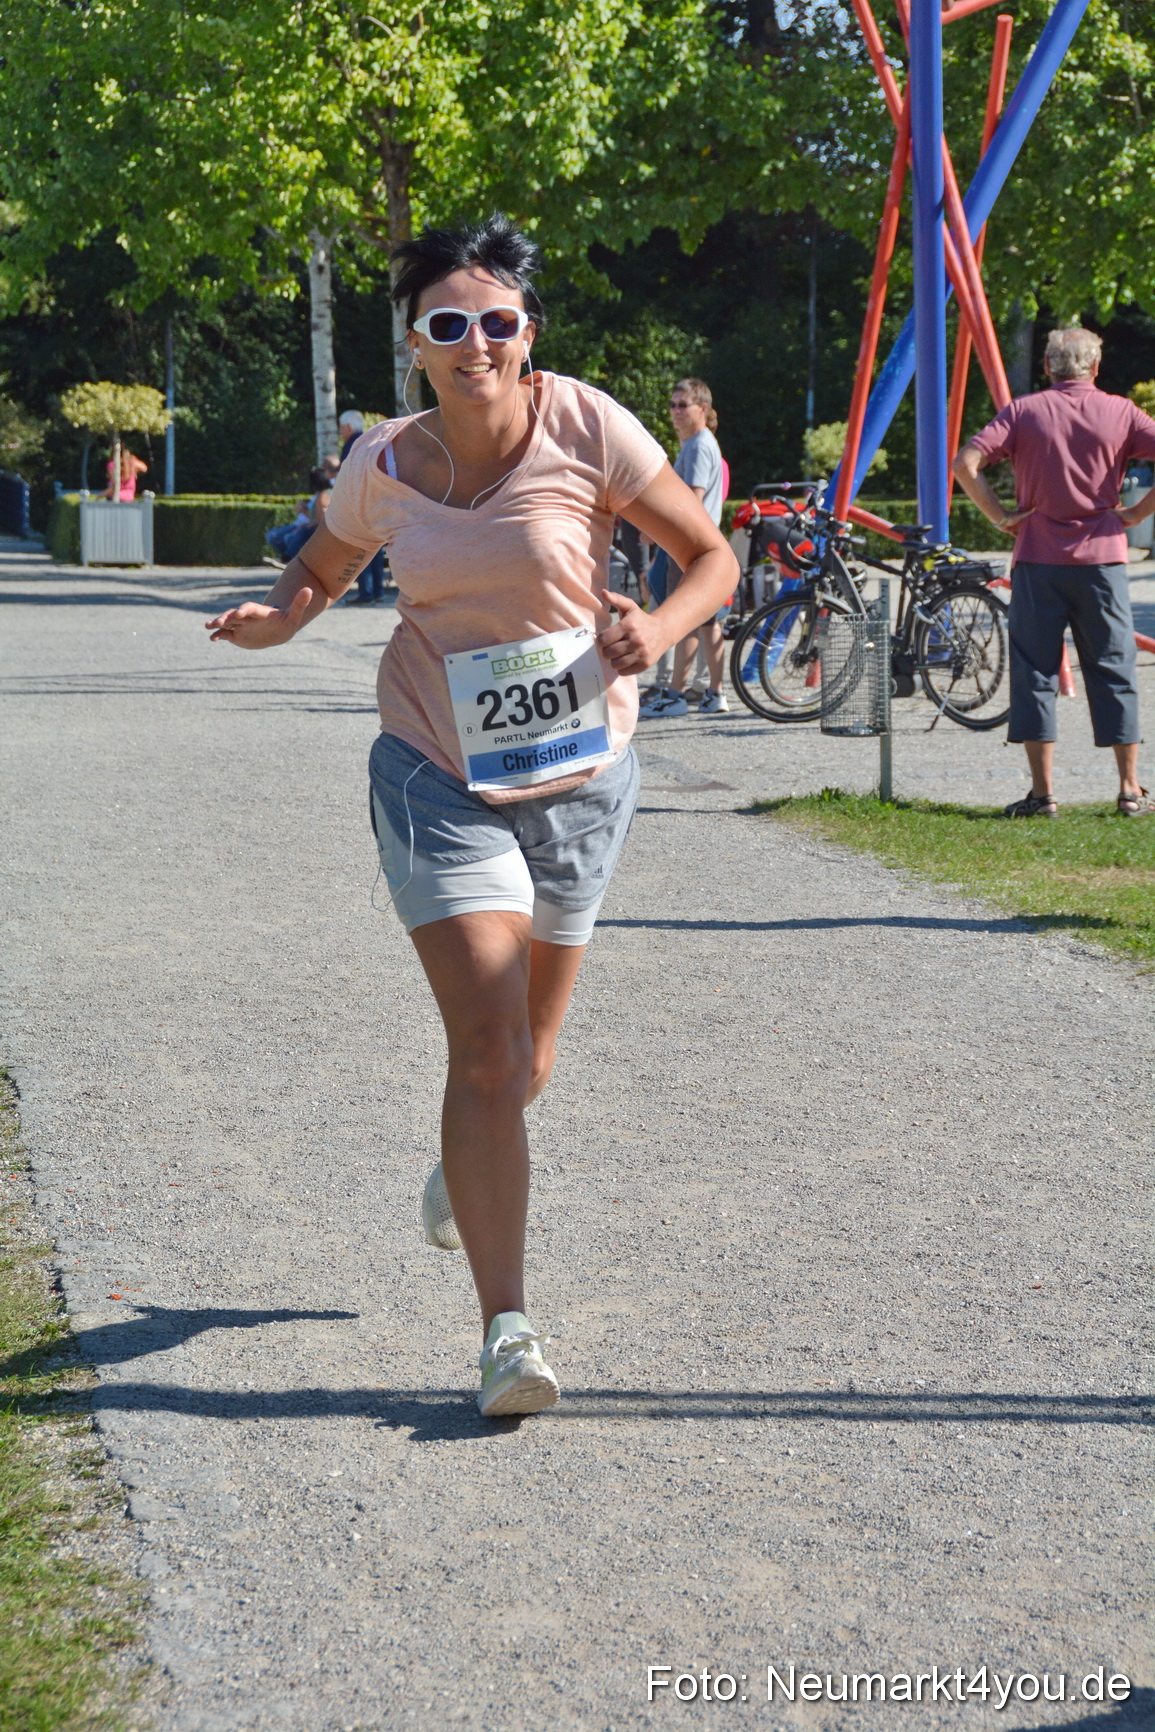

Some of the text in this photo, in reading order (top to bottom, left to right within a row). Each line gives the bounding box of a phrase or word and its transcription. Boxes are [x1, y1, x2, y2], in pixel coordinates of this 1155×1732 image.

[491, 648, 557, 675] BOCK
[476, 671, 579, 732] 2361
[466, 726, 473, 734] D
[494, 723, 568, 745] PARTL Neumarkt
[502, 742, 578, 772] Christine
